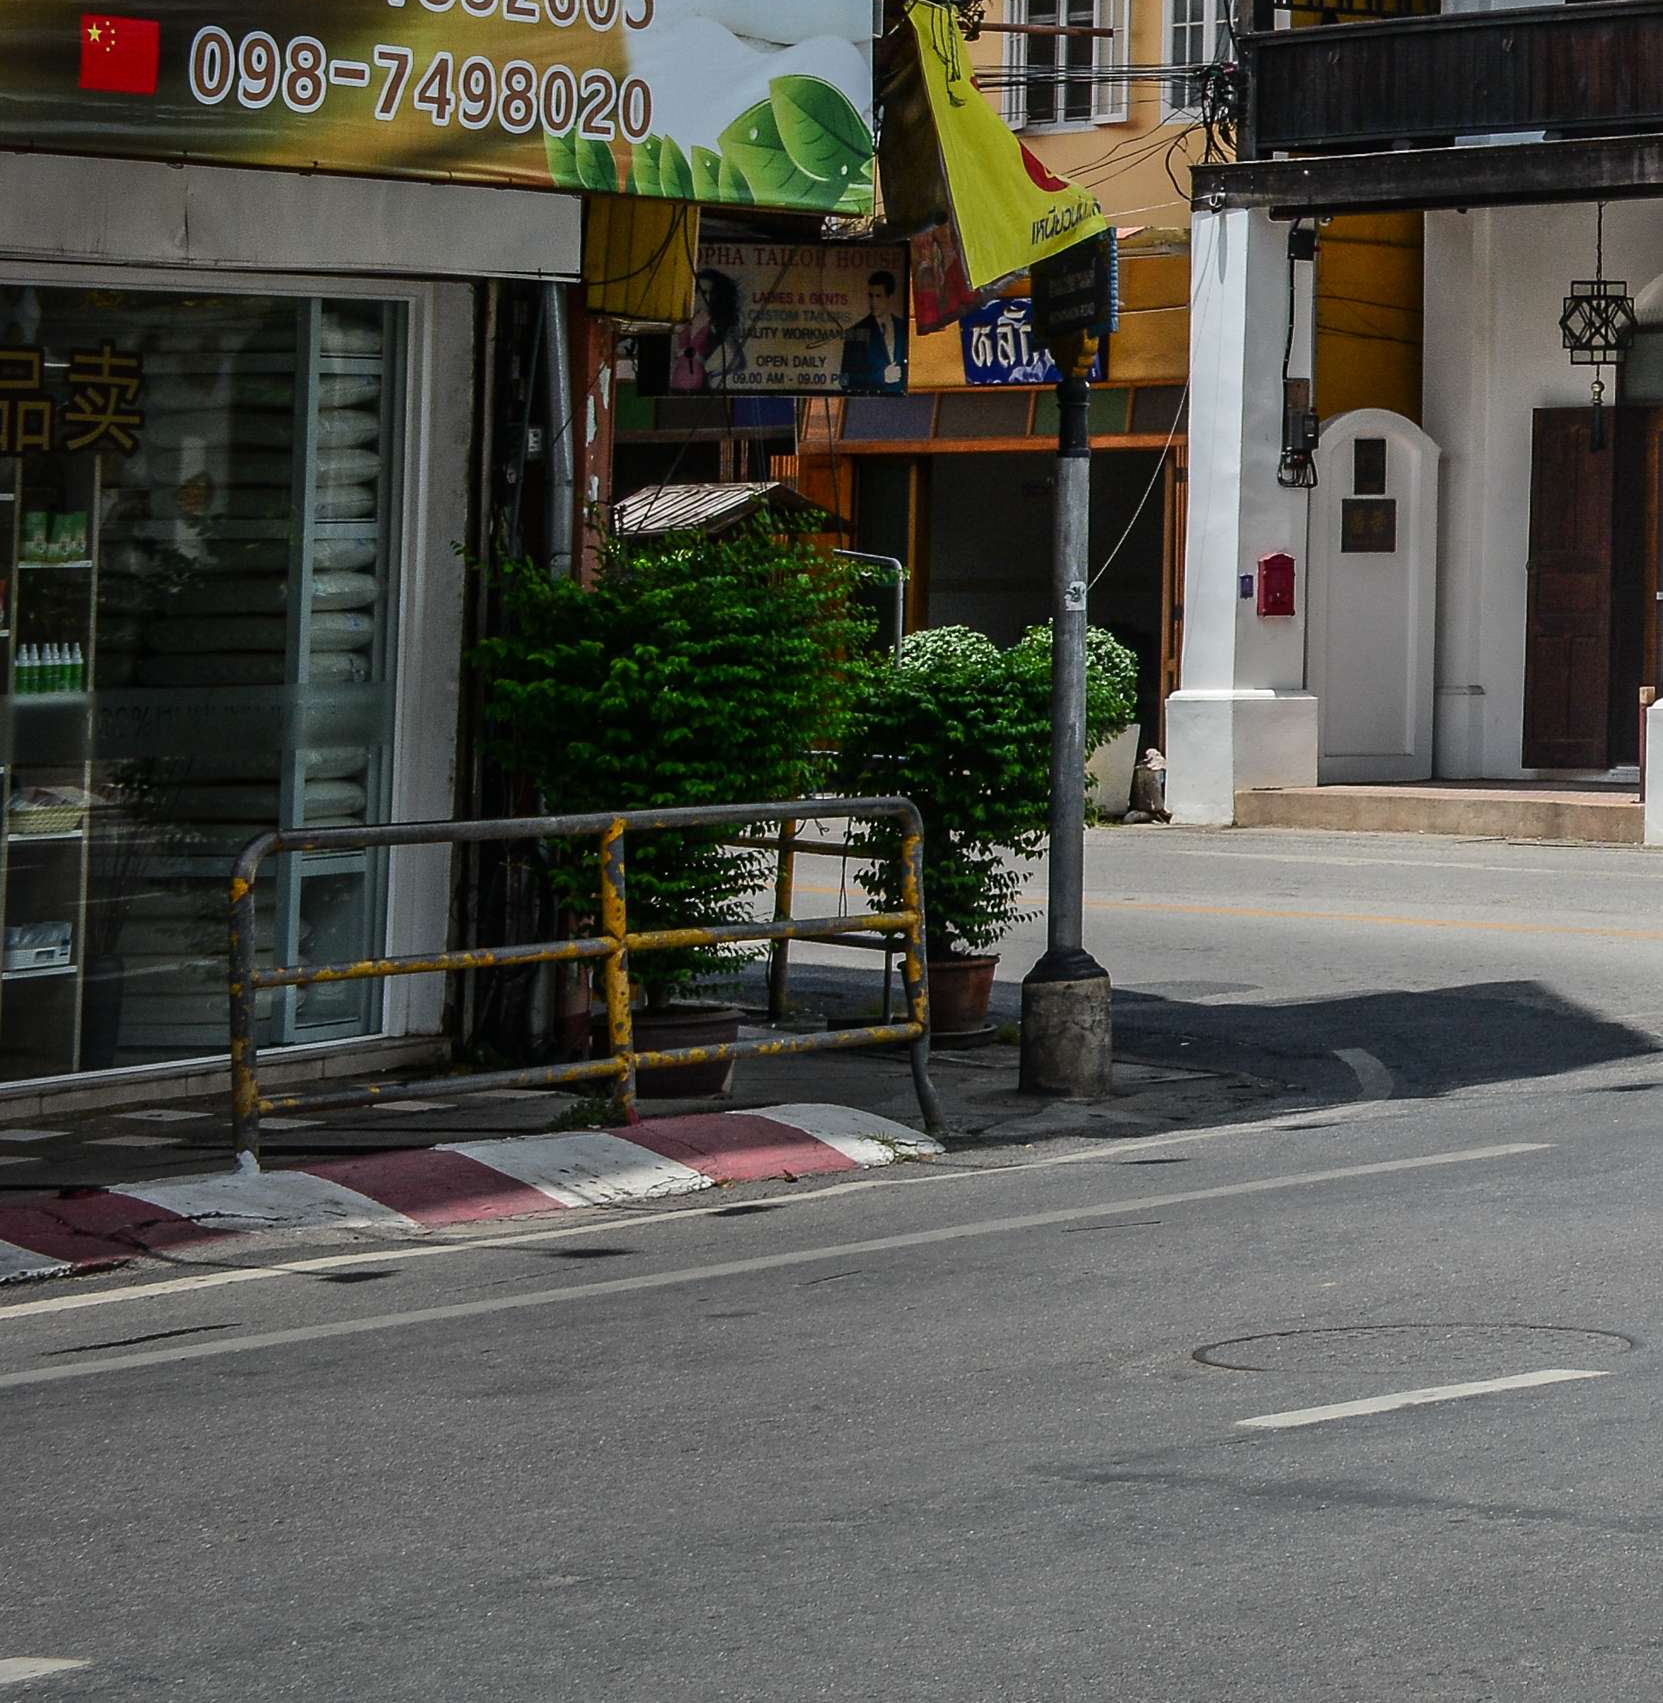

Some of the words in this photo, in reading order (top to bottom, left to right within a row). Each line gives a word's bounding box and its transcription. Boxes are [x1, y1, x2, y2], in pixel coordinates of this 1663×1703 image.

[190, 25, 653, 143] 098-7498020
[753, 248, 826, 267] TAILOR
[752, 292, 793, 305] LADIES
[811, 292, 849, 305] GENTS
[756, 356, 789, 368] OPEN
[793, 356, 827, 368] DAILY
[766, 372, 785, 384] AM
[799, 373, 827, 385] 09.00
